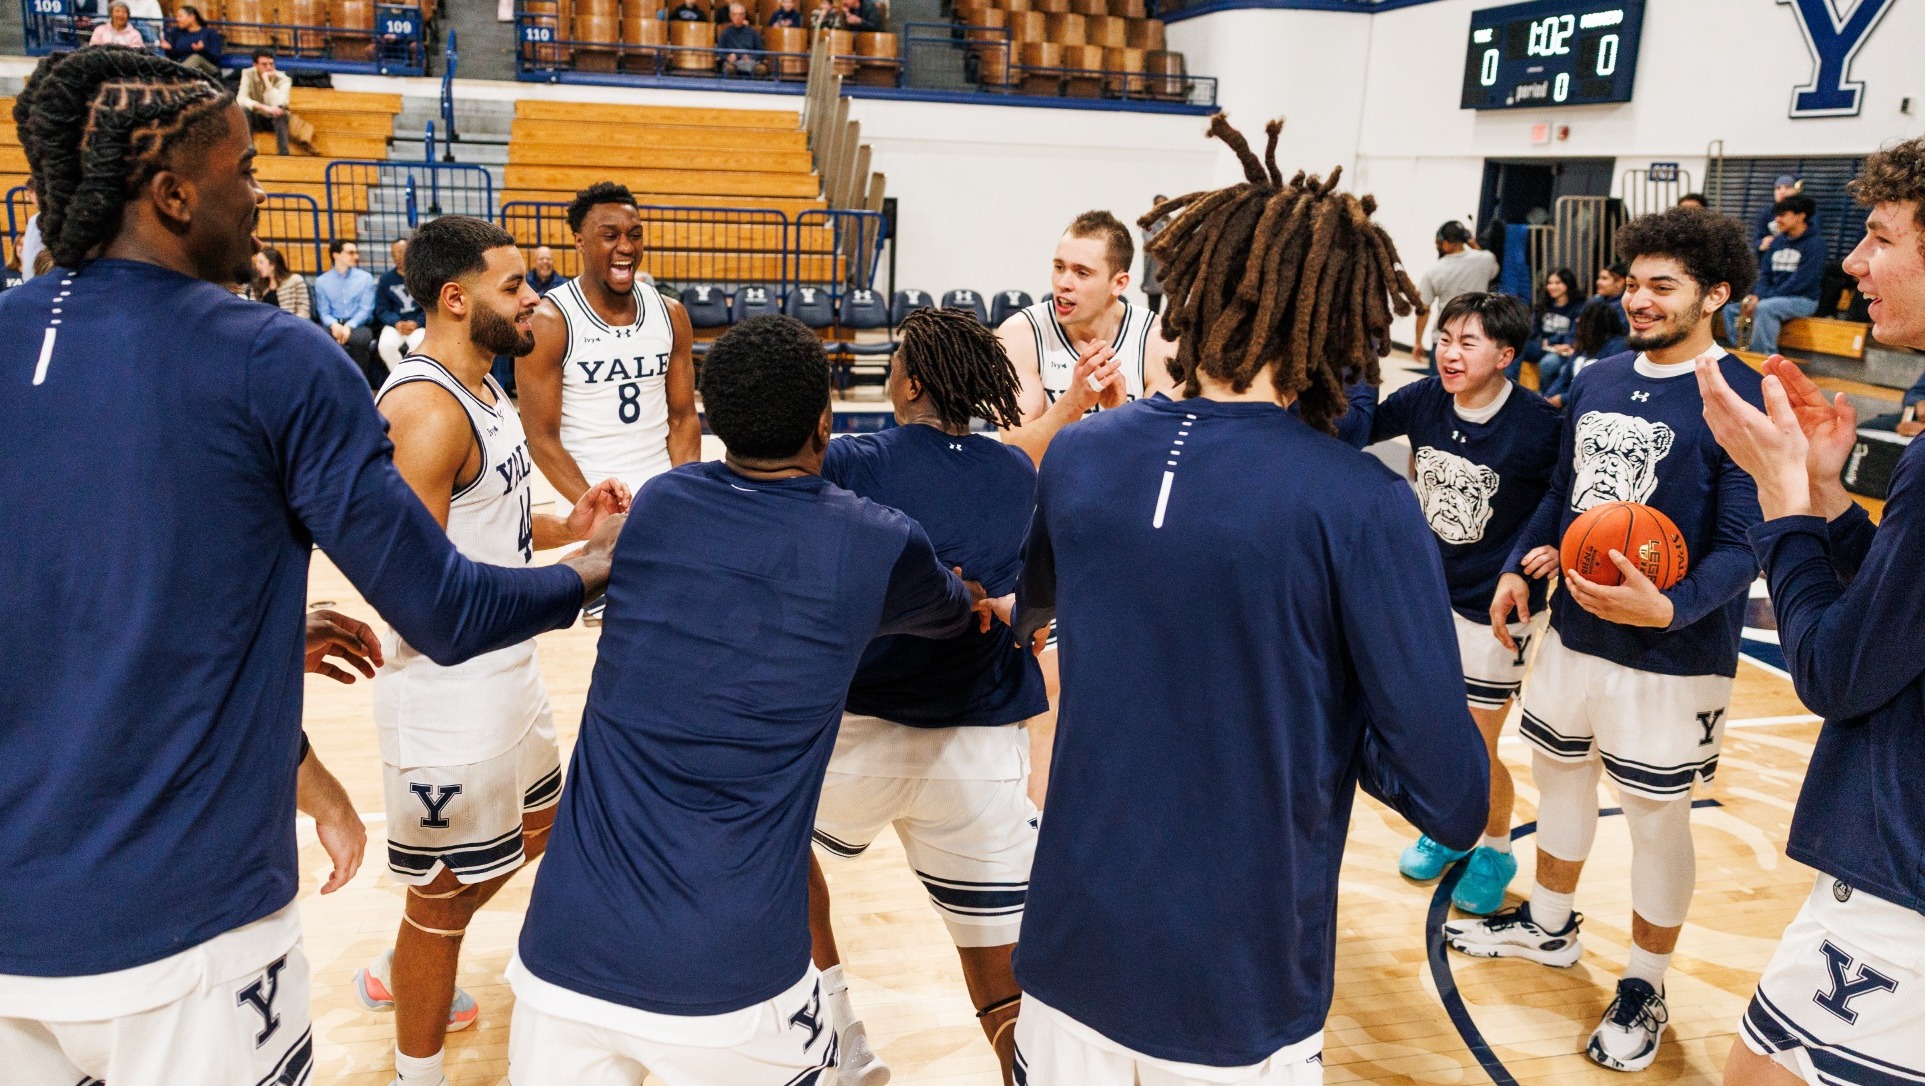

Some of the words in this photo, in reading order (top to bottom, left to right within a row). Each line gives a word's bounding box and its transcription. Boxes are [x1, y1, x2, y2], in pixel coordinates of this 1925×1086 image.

[34, 0, 62, 13] 109
[386, 20, 412, 34] 109
[525, 28, 550, 42] 110
[1527, 14, 1575, 56] 1:02
[1596, 34, 1619, 76] 0
[1480, 48, 1500, 86] 0
[1776, 0, 1895, 119] Y
[1515, 80, 1549, 102] period
[1553, 72, 1570, 102] 0
[389, 284, 416, 314] Y
[577, 353, 669, 384] YALE
[619, 382, 641, 424] 8
[496, 439, 532, 496] YAL
[1696, 707, 1725, 747] Y
[409, 782, 462, 828] Y
[236, 954, 287, 1049] Y
[1812, 939, 1899, 1025] Y
[788, 977, 824, 1054] Y
